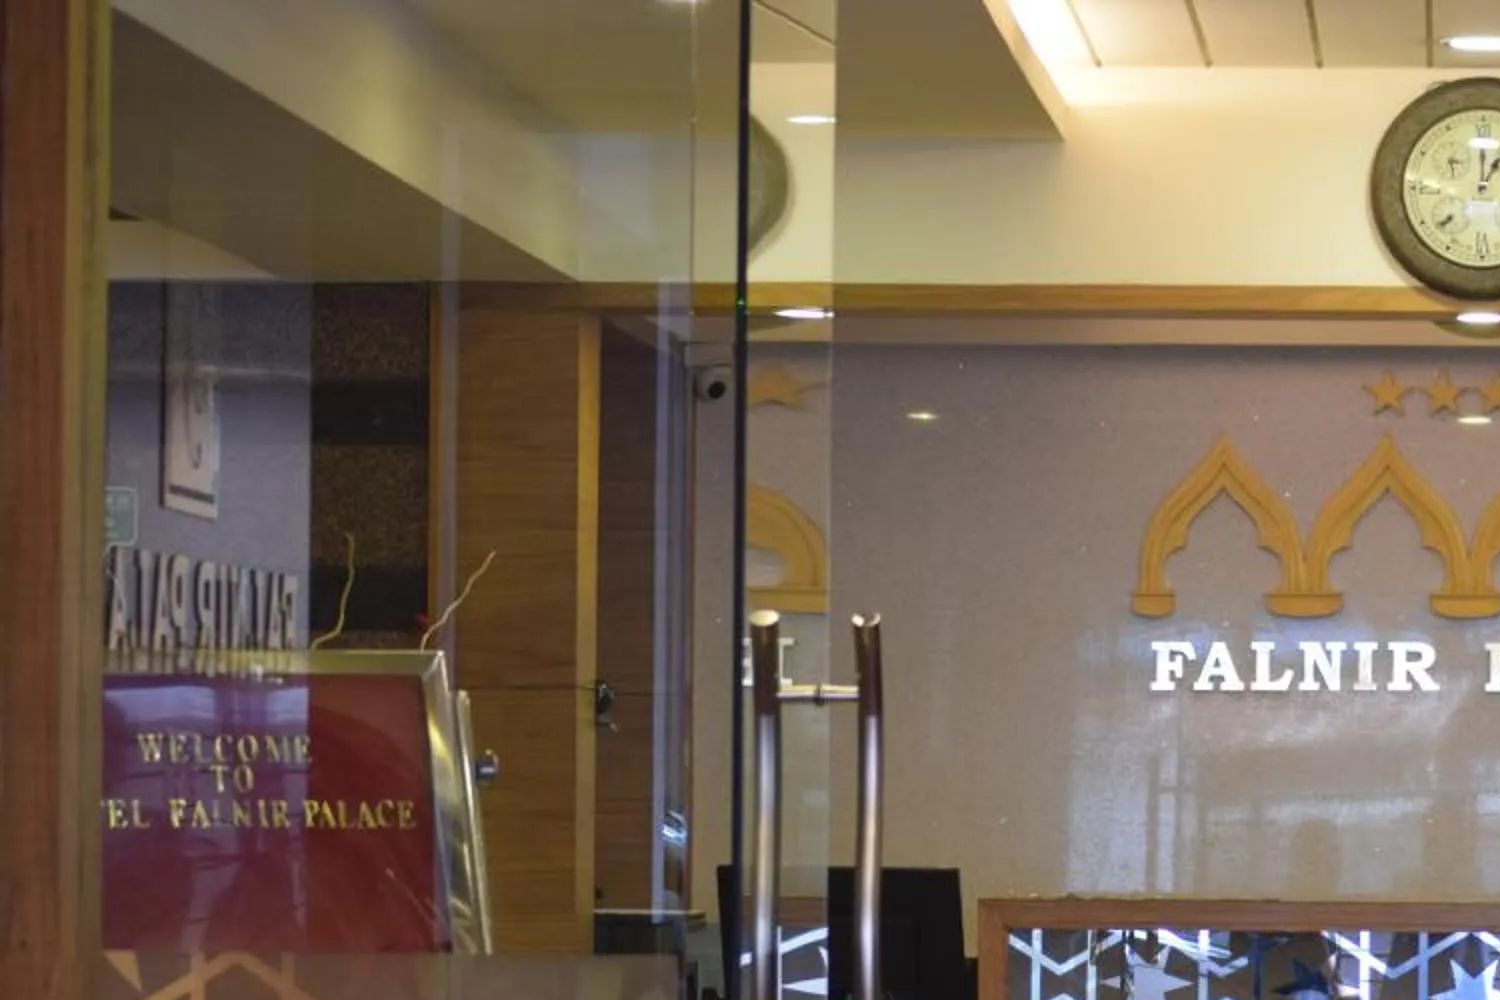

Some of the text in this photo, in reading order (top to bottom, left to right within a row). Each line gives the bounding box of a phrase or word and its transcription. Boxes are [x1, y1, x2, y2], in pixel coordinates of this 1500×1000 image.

[1150, 639, 1440, 692] FALNIR
[137, 733, 312, 763] WELCOME
[209, 764, 255, 793] TO
[101, 799, 150, 829] EL
[303, 799, 416, 829] PALACE
